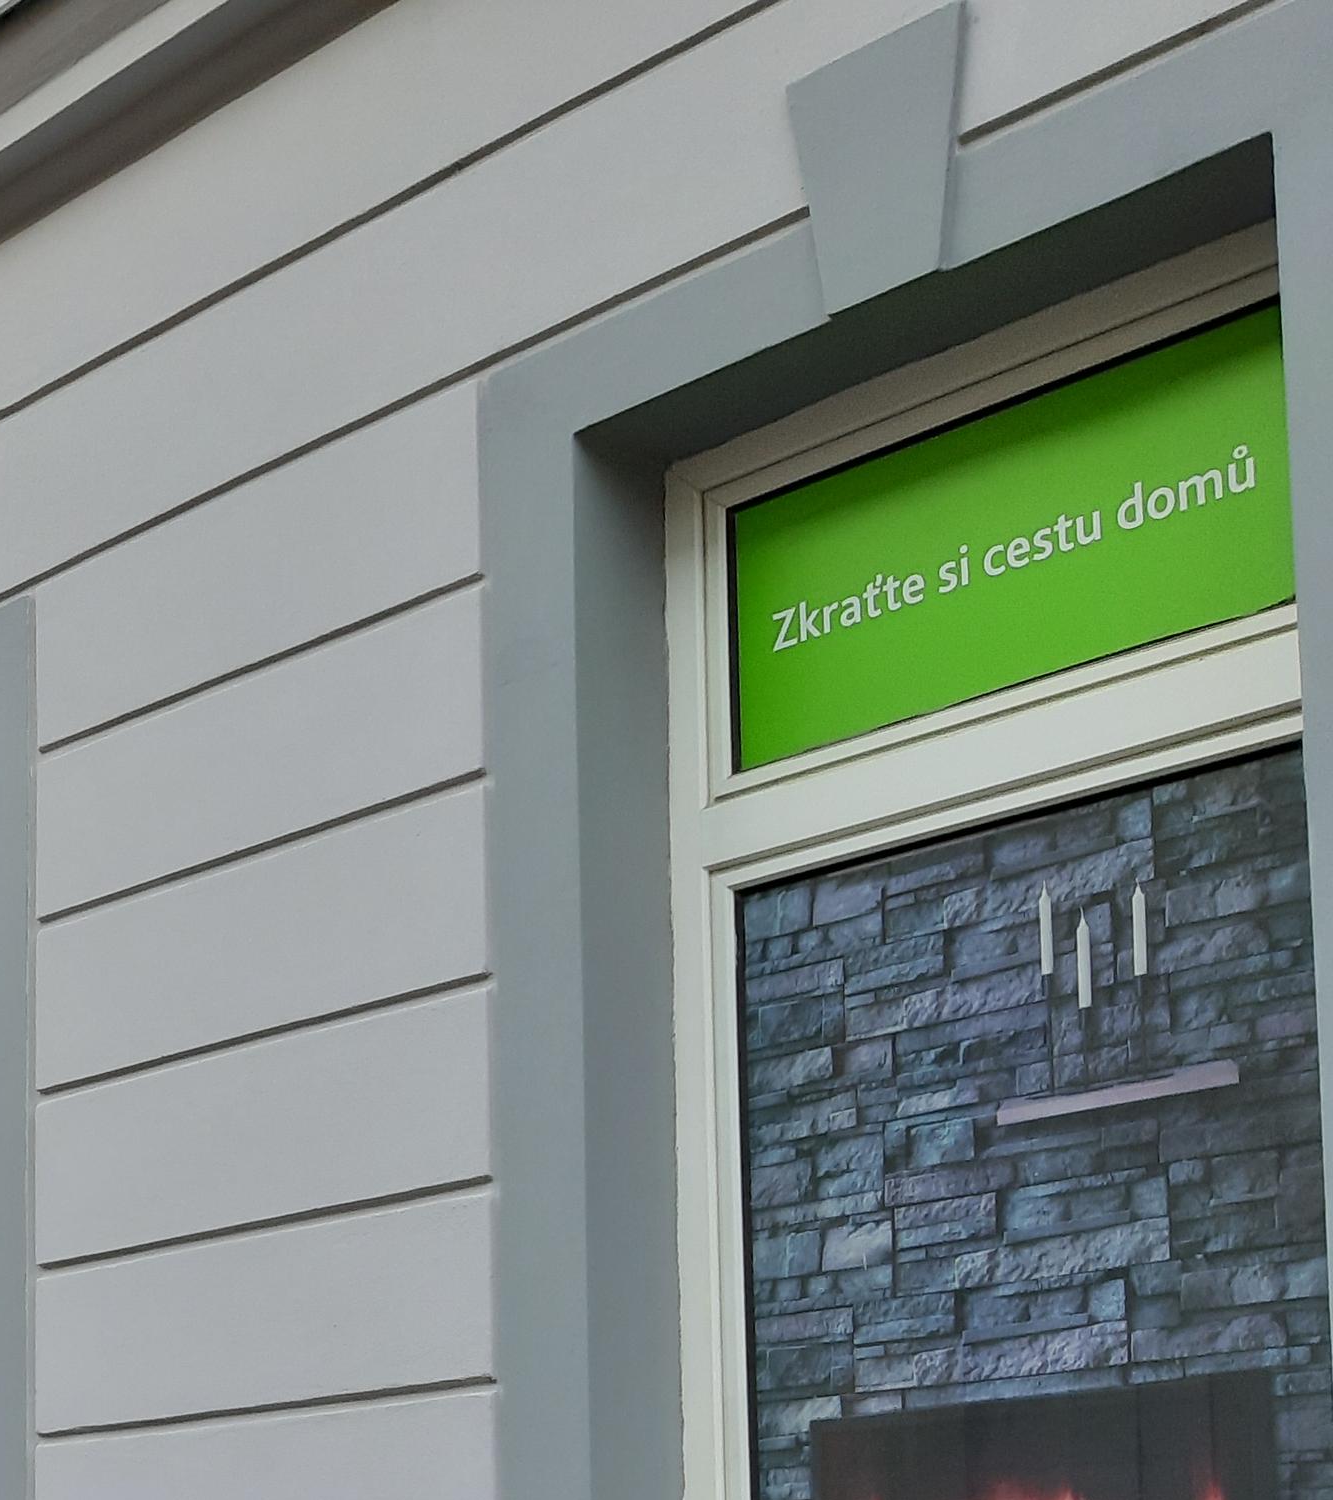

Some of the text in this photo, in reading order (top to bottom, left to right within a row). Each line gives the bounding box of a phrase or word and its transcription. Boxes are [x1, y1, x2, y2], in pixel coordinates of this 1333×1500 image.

[771, 444, 1257, 654] Zkraťte si cestu domů
